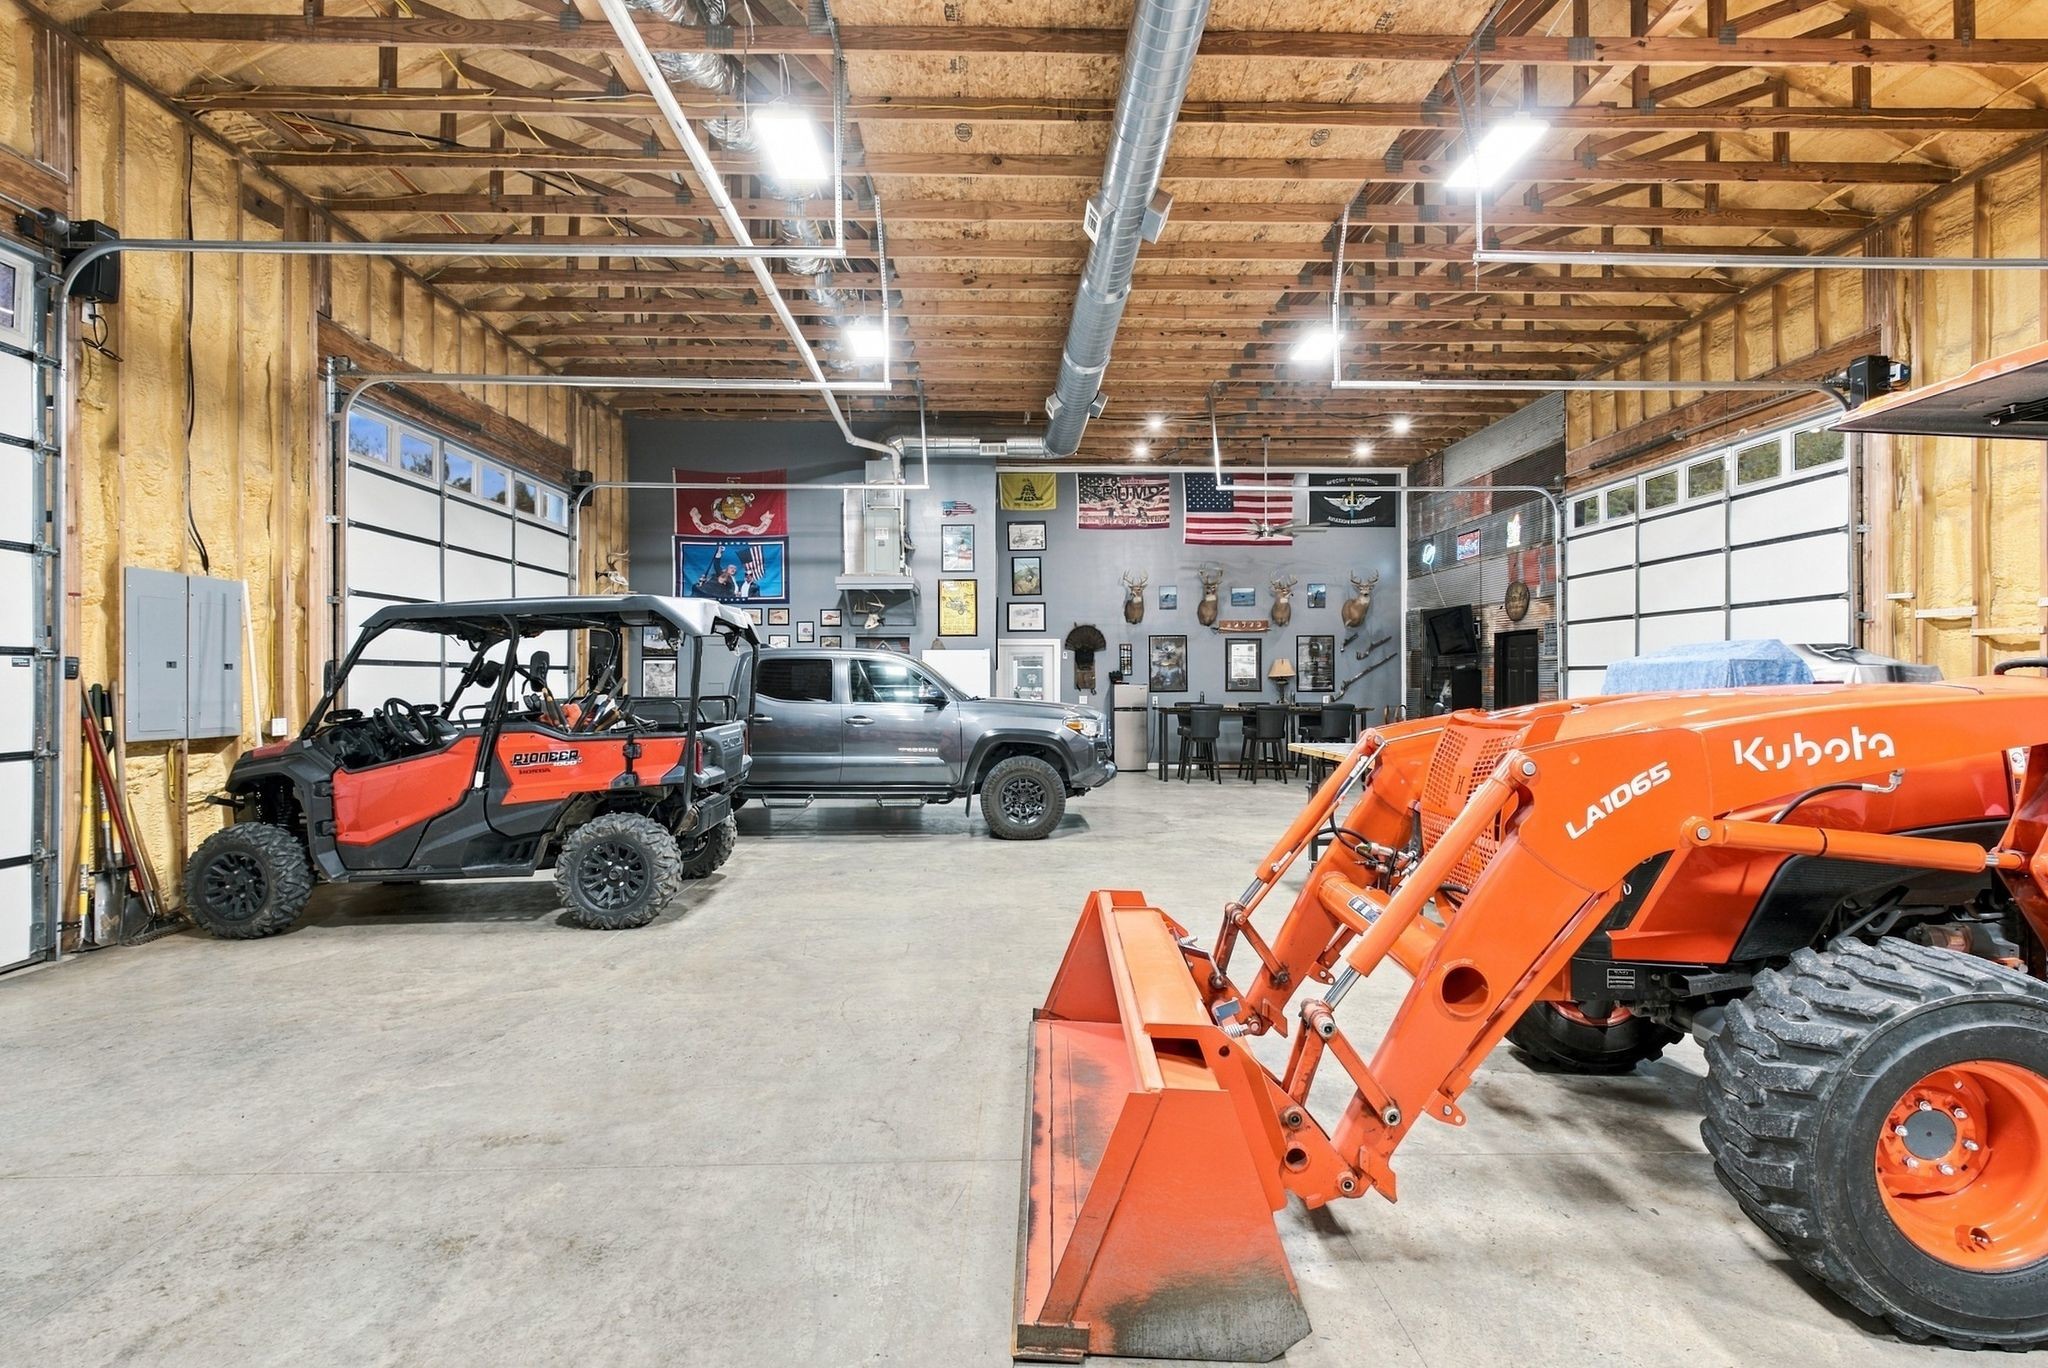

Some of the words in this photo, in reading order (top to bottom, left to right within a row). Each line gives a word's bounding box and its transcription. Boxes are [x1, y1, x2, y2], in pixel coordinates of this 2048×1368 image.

[512, 750, 579, 765] PIONEER
[1733, 726, 1896, 772] Kubota
[1565, 761, 1672, 840] LA1065
